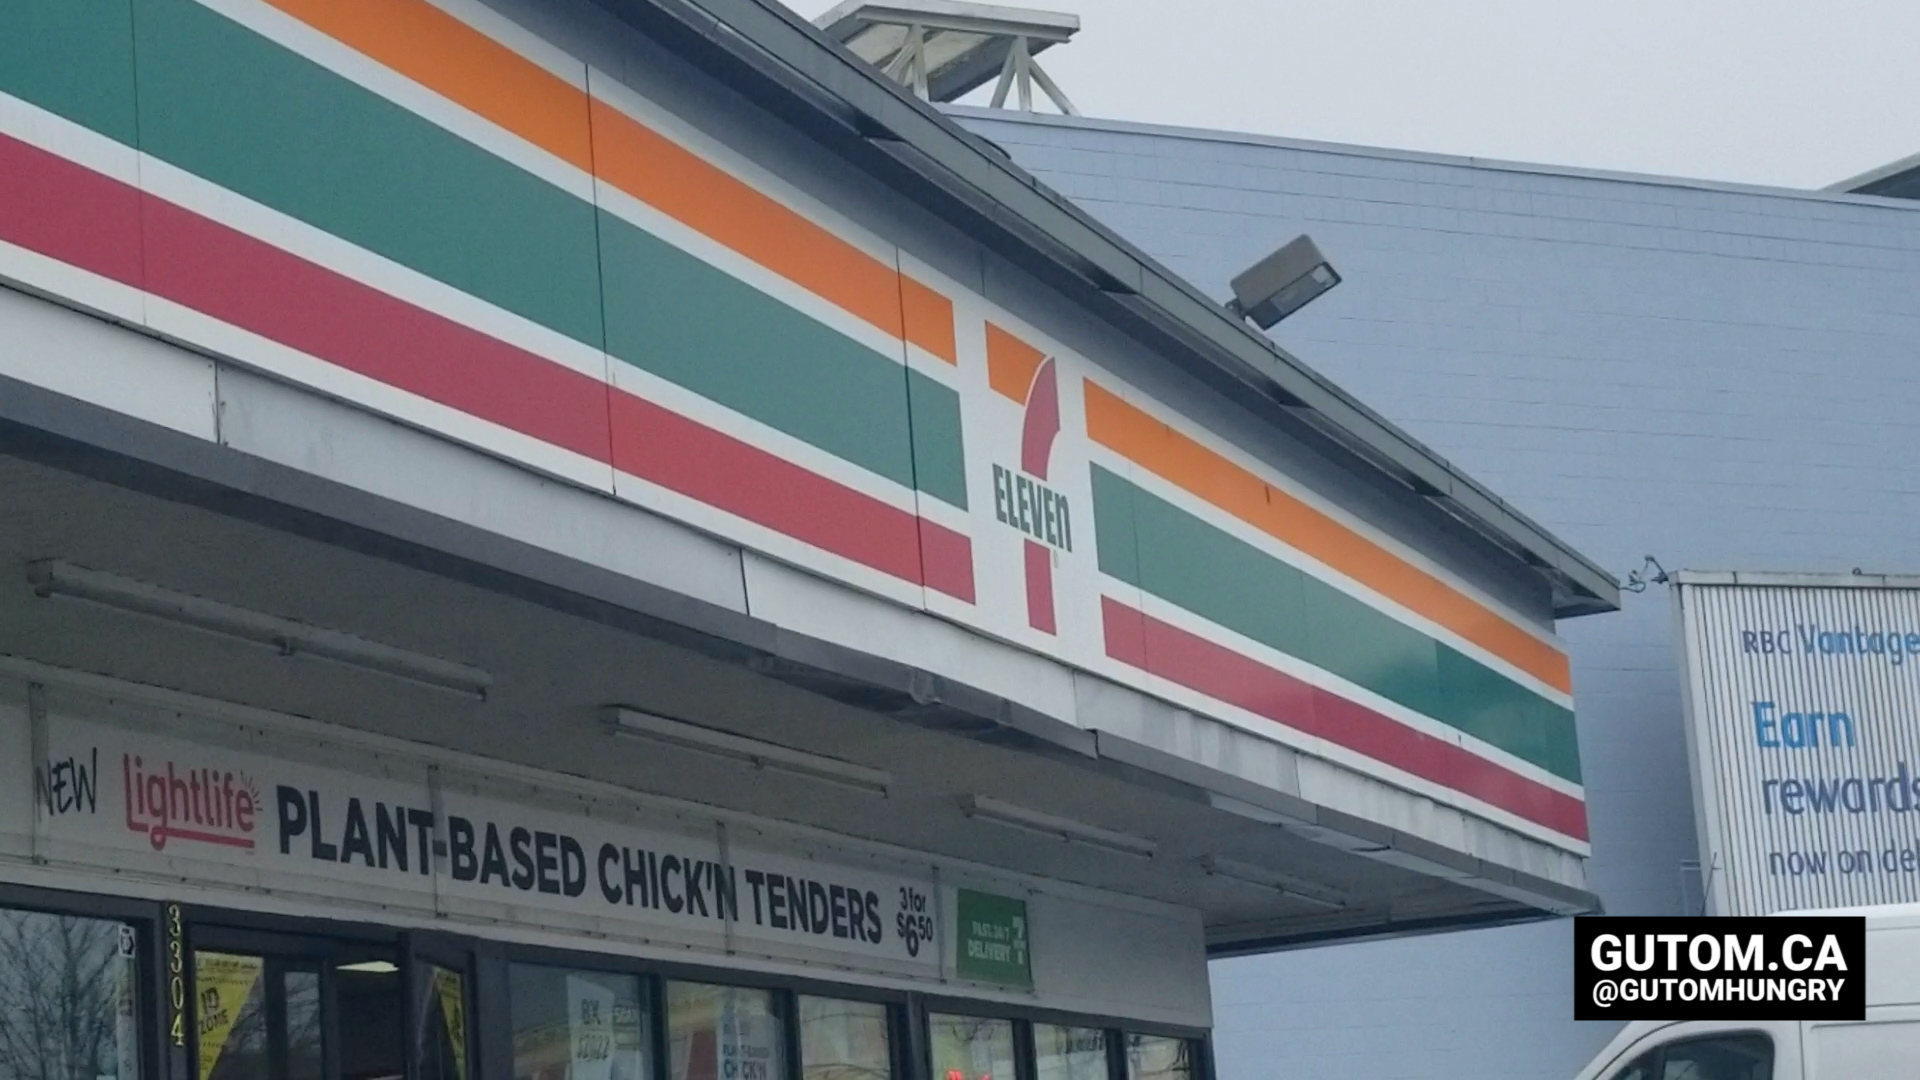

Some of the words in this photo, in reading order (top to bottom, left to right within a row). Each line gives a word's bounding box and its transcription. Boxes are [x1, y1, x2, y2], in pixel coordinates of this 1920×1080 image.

[1743, 630, 1792, 654] RBC
[1798, 624, 1920, 666] Vantage
[1752, 700, 1855, 749] Earn
[36, 747, 98, 816] NEW
[276, 784, 587, 898] PLANT-BASED
[598, 841, 738, 922] CHICK'N
[745, 869, 882, 944] TENDERS
[1770, 850, 1827, 876] now
[1838, 849, 1873, 874] on
[899, 887, 909, 911] 3
[909, 887, 926, 913] for
[967, 938, 1012, 963] DELIVERY
[166, 904, 187, 1048] 3304
